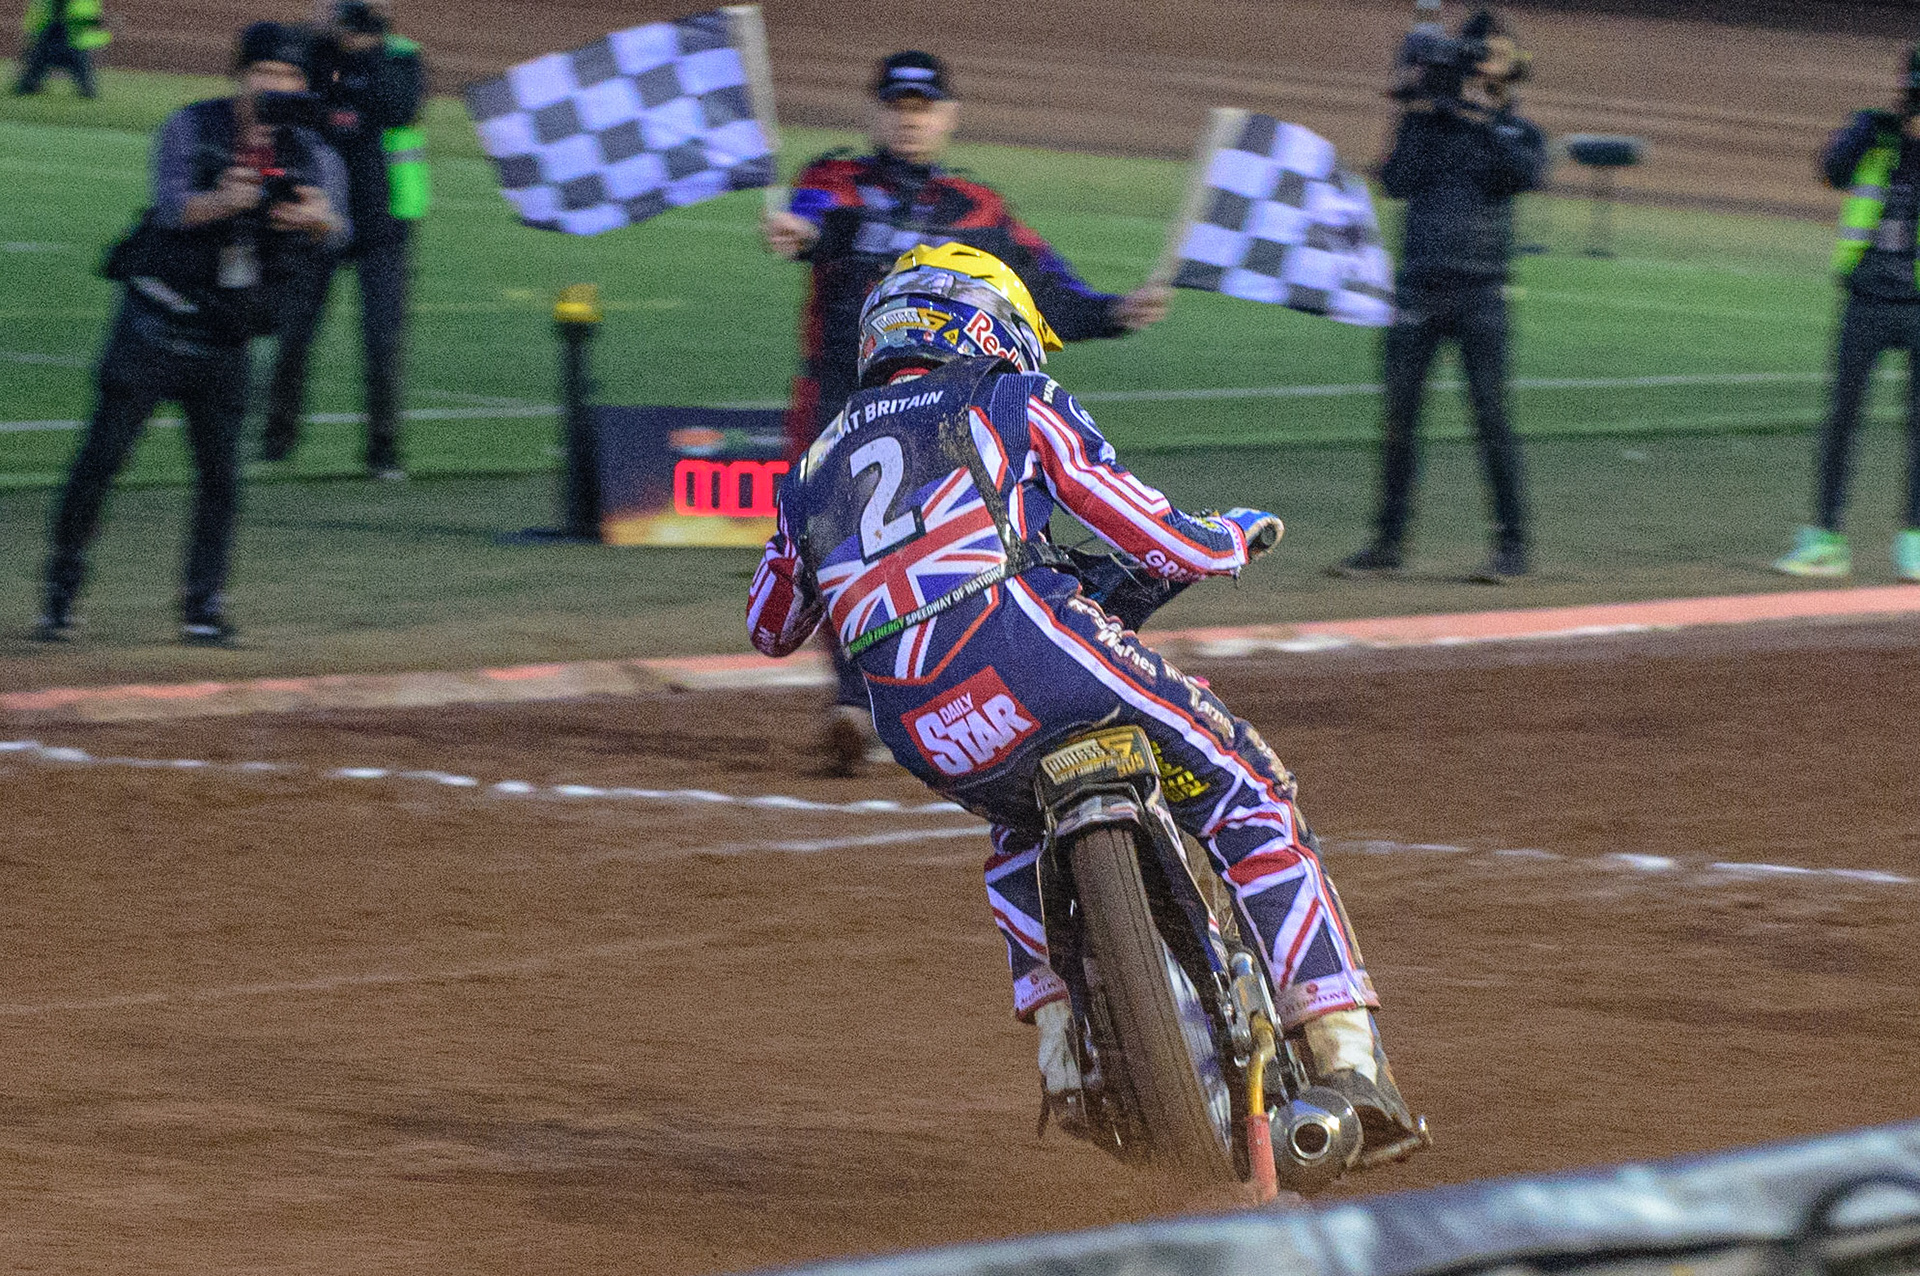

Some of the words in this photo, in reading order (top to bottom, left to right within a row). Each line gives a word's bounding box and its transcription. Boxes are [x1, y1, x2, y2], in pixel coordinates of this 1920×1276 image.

[865, 390, 944, 423] BRITAIN
[849, 436, 923, 564] 2
[906, 595, 951, 625] SPEEDWAY
[953, 587, 965, 602] OF
[939, 692, 974, 725] DAILY
[914, 694, 1033, 775] STAR
